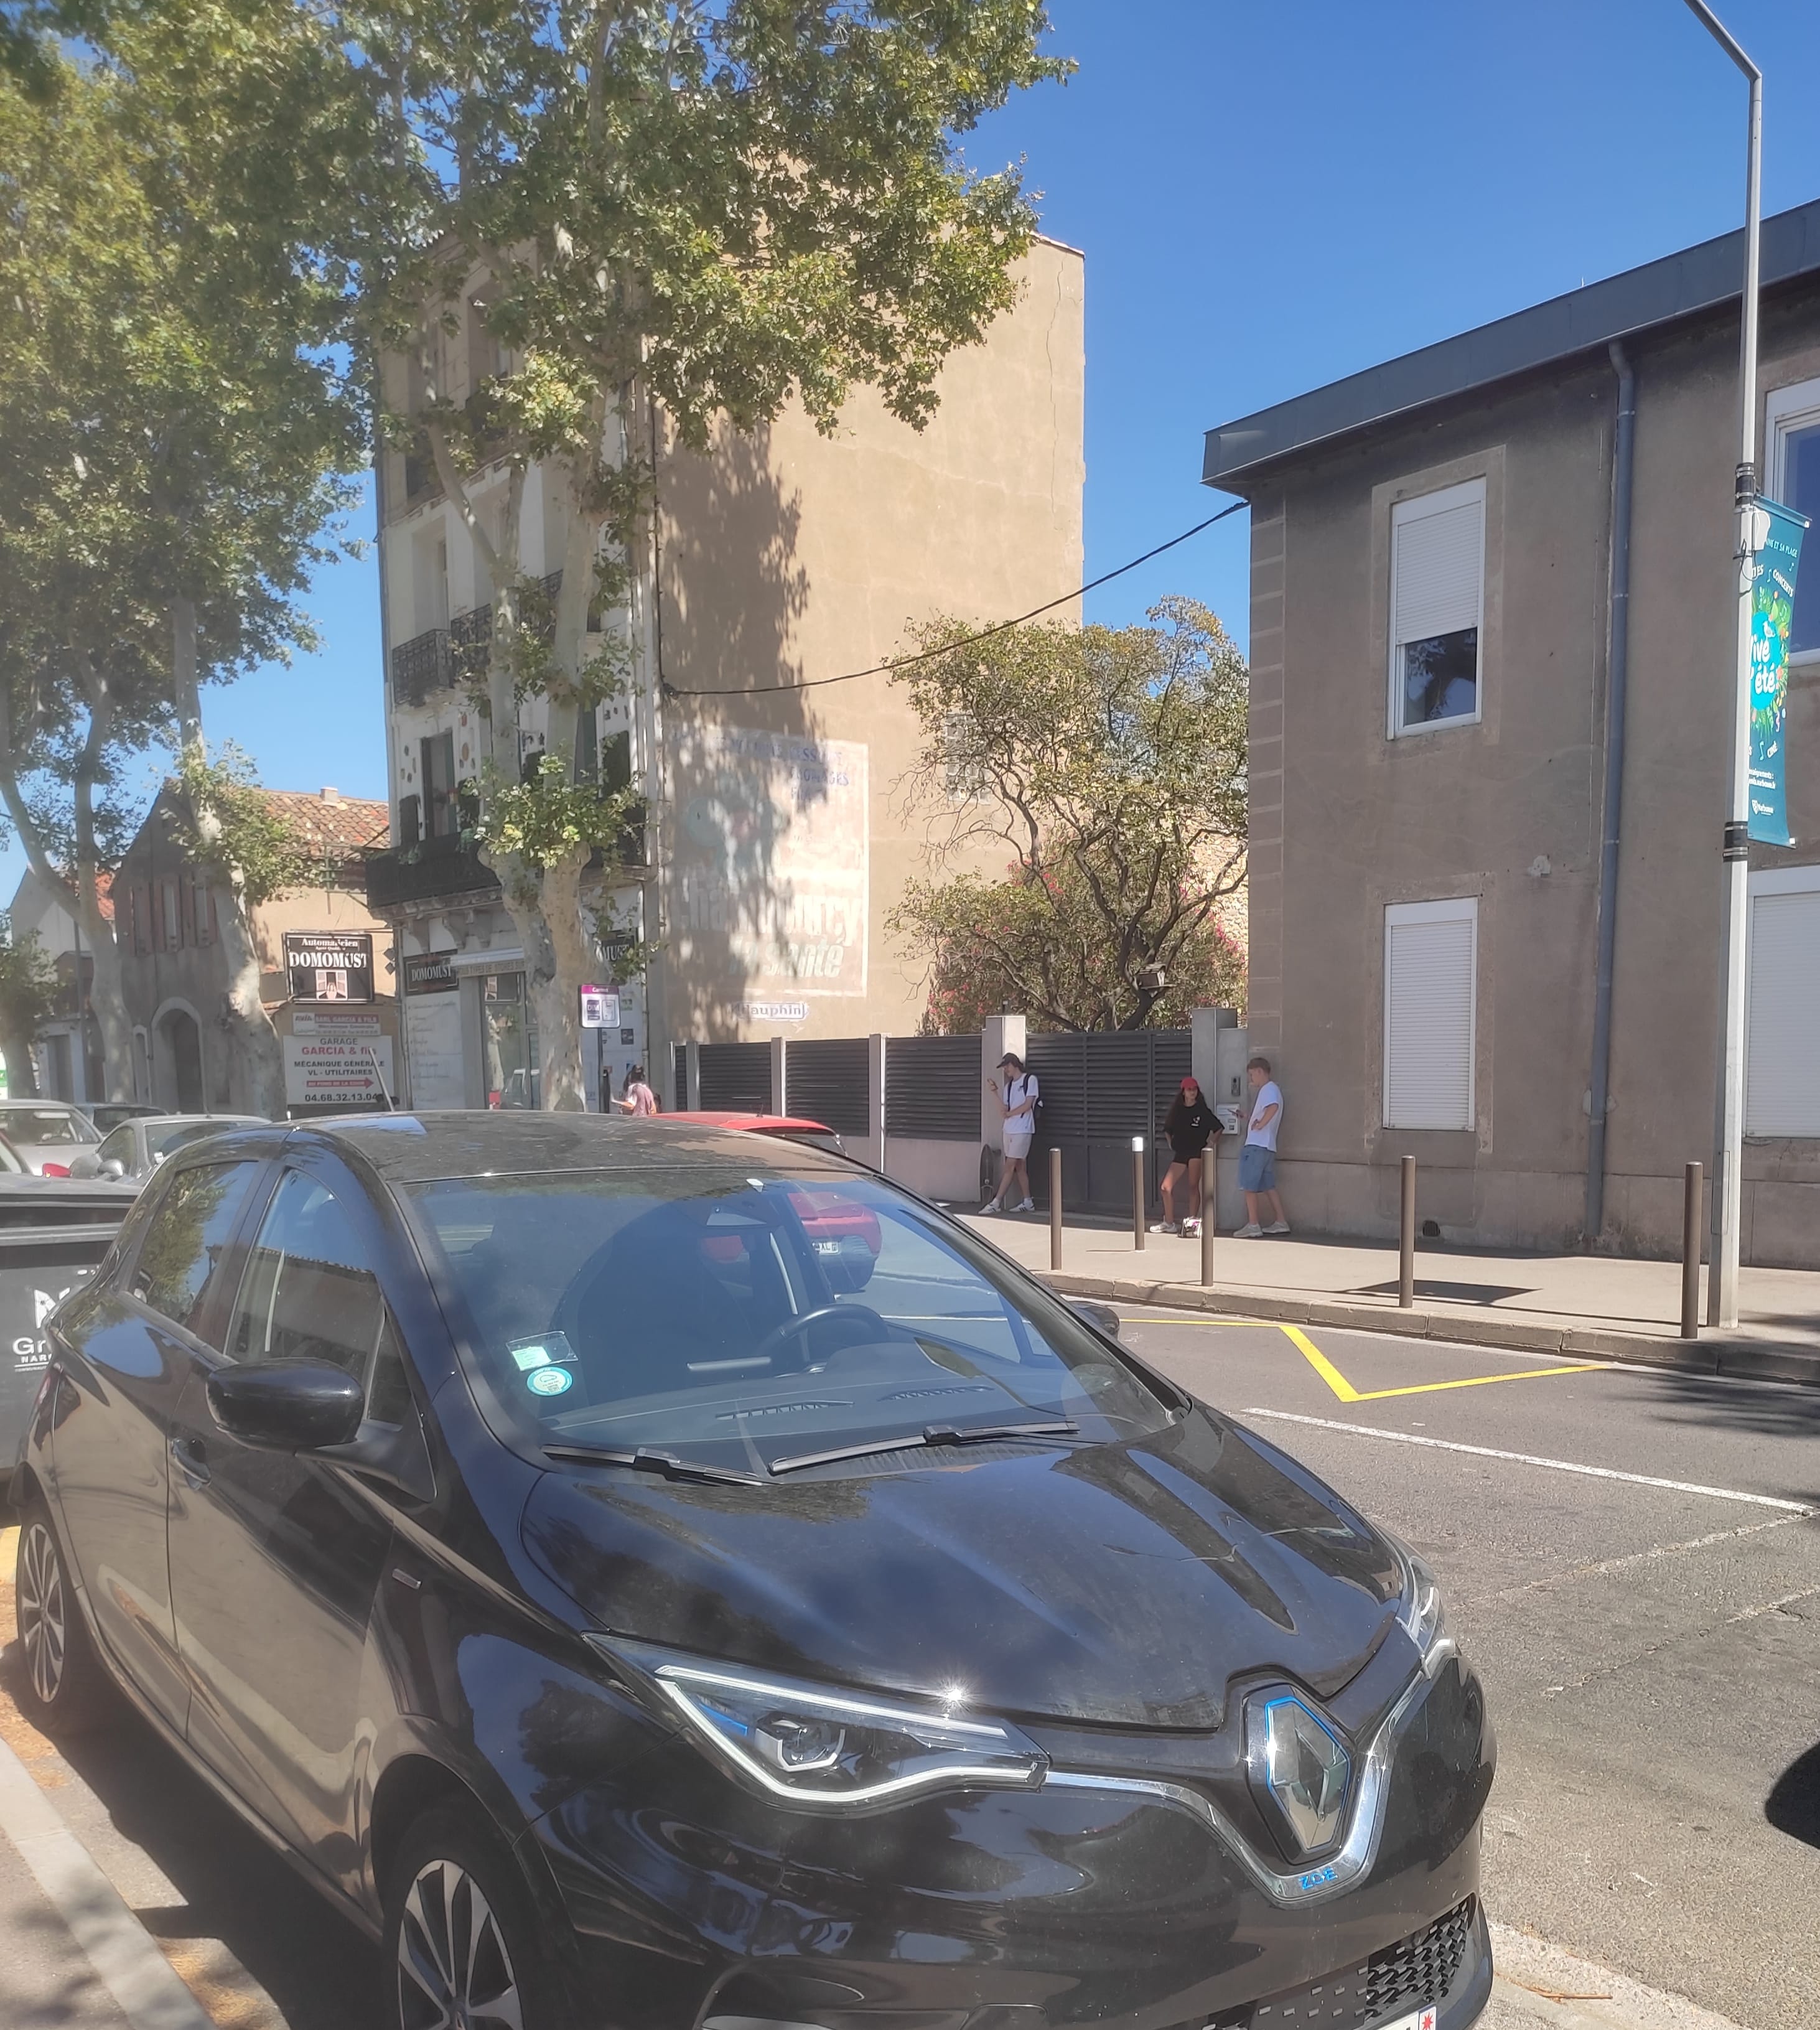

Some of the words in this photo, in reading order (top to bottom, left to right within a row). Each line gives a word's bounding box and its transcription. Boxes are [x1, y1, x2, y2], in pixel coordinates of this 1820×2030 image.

[1785, 545, 1798, 558] PLAGE
[1773, 569, 1793, 597] CONCERTS
[411, 965, 452, 981] DOMOMUST
[302, 1047, 345, 1055] GARCIA
[349, 1047, 357, 1055] &
[1298, 1866, 1338, 1890] ZOE
